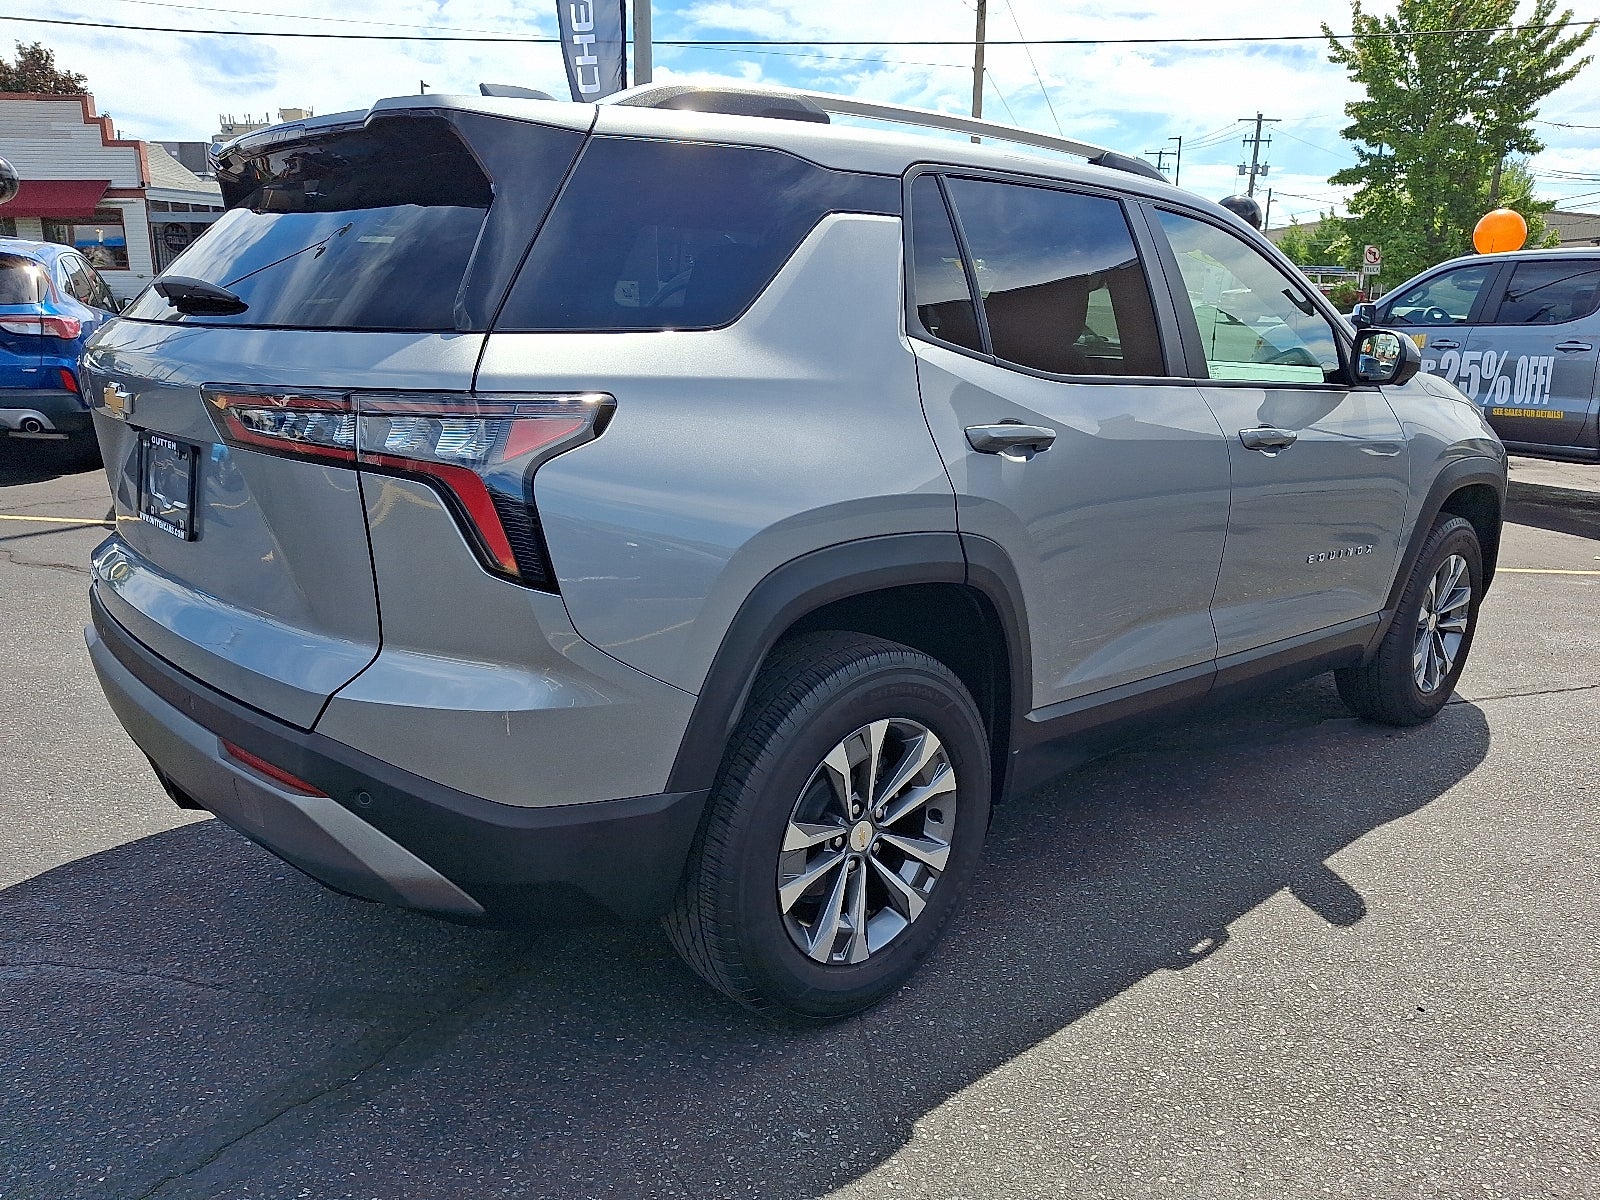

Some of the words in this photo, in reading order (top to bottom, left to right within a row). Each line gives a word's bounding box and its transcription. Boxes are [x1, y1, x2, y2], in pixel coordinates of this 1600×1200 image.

[570, 0, 600, 93] CHE
[1440, 350, 1511, 405] 25%
[1513, 355, 1555, 405] OFF!
[1492, 407, 1503, 416] SEE
[1504, 408, 1522, 417] SALES
[1523, 409, 1535, 418] FOR
[1536, 410, 1564, 419] DETAILS!
[151, 435, 177, 451] OUTTEN
[1307, 544, 1373, 564] EQUINOX
